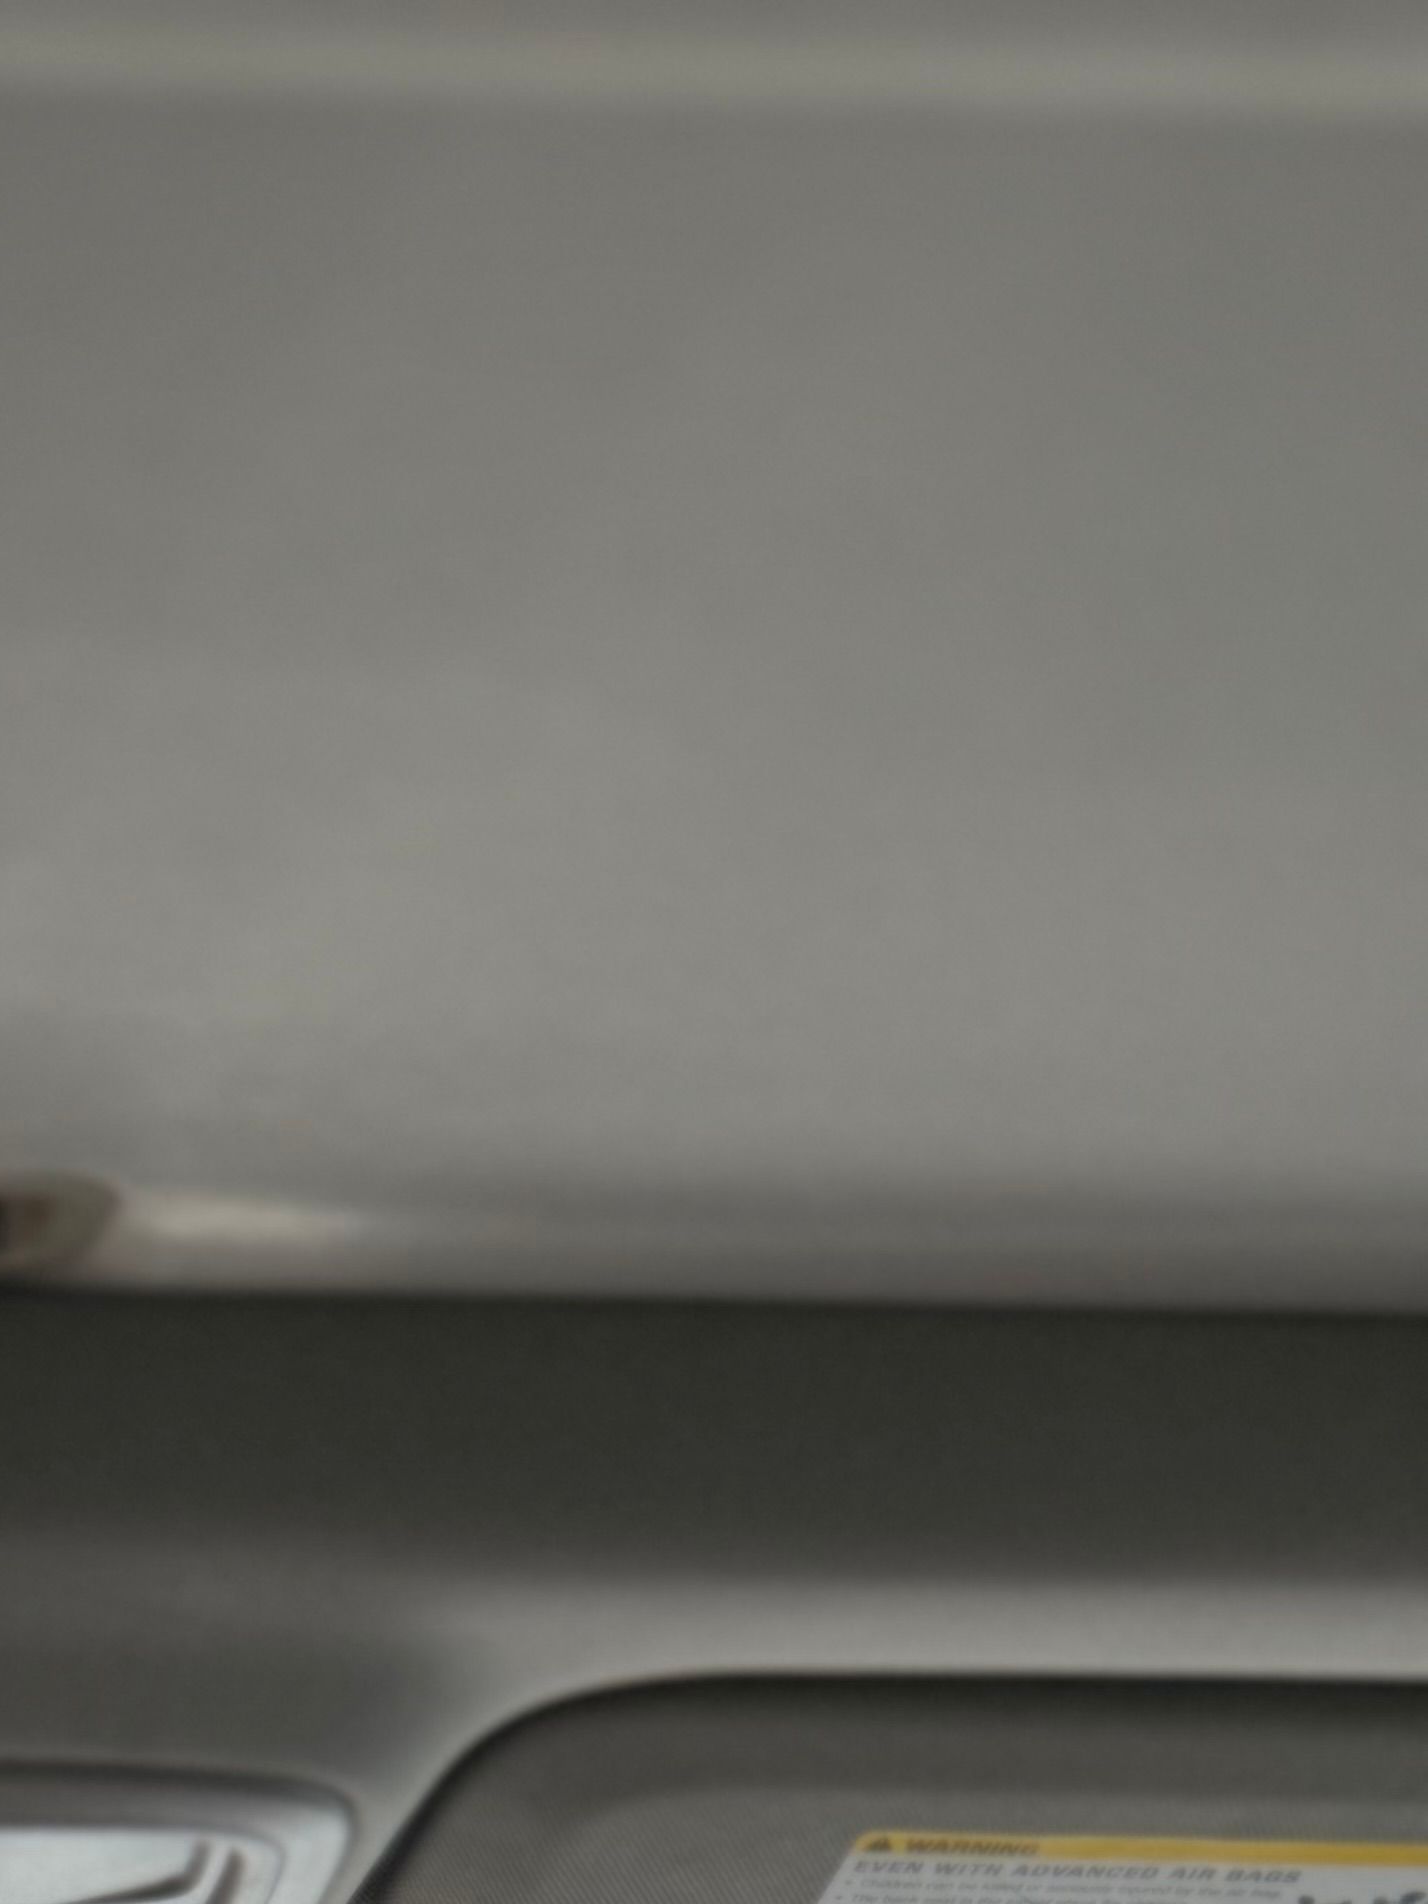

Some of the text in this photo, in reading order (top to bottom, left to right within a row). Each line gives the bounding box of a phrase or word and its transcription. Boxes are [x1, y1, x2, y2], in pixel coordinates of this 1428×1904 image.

[906, 1837, 1040, 1856] WARNING
[853, 1861, 1302, 1883] EVEN WITH ADVANCED AIR BAGS
